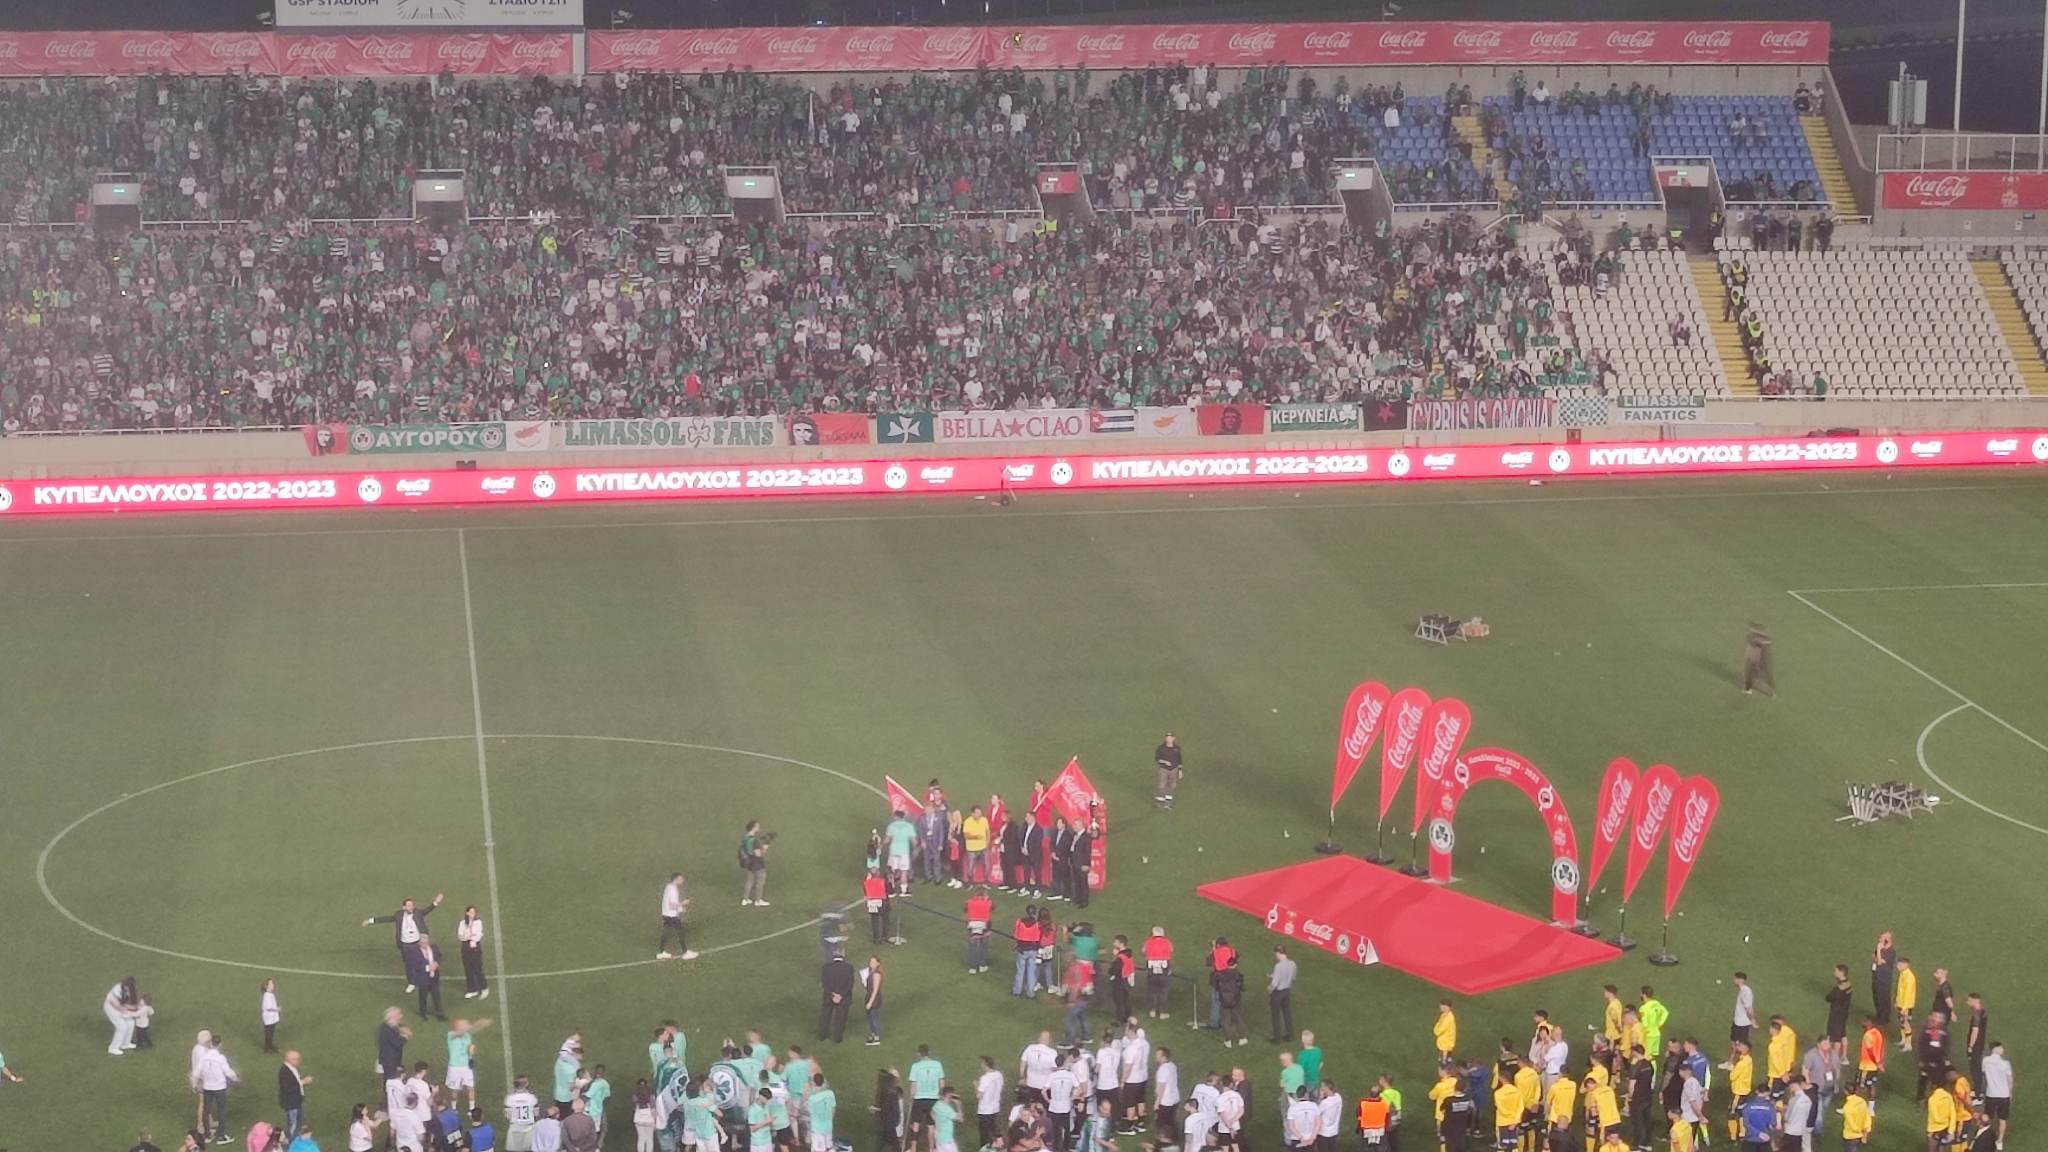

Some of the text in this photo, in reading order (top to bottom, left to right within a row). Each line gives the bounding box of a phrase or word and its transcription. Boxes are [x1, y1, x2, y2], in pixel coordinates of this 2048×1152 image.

[1906, 175, 1969, 197] Coca-Cola
[942, 416, 1083, 438] BELLA CIAO
[1412, 399, 1550, 431] CYPRUS IS OMONIA
[1625, 410, 1697, 421] FANATICS
[376, 430, 480, 447] ΑΥΓΟΡΟΥ
[565, 421, 774, 446] LIMASSOL FANS
[1589, 442, 1857, 466] ΚΥΠΕΛΛΟΥΧΟΣ 2022-2023
[1092, 455, 1368, 479] ΚΥΠΕΛΛΟΥΧΟΣ 2022-2023
[576, 467, 864, 492] ΚΥΠΕΛΛΟΥΧΟΣ 2022-2023
[34, 480, 336, 505] ΚΥΠΕΛΛΟΥΧΟΣ 2022-2023
